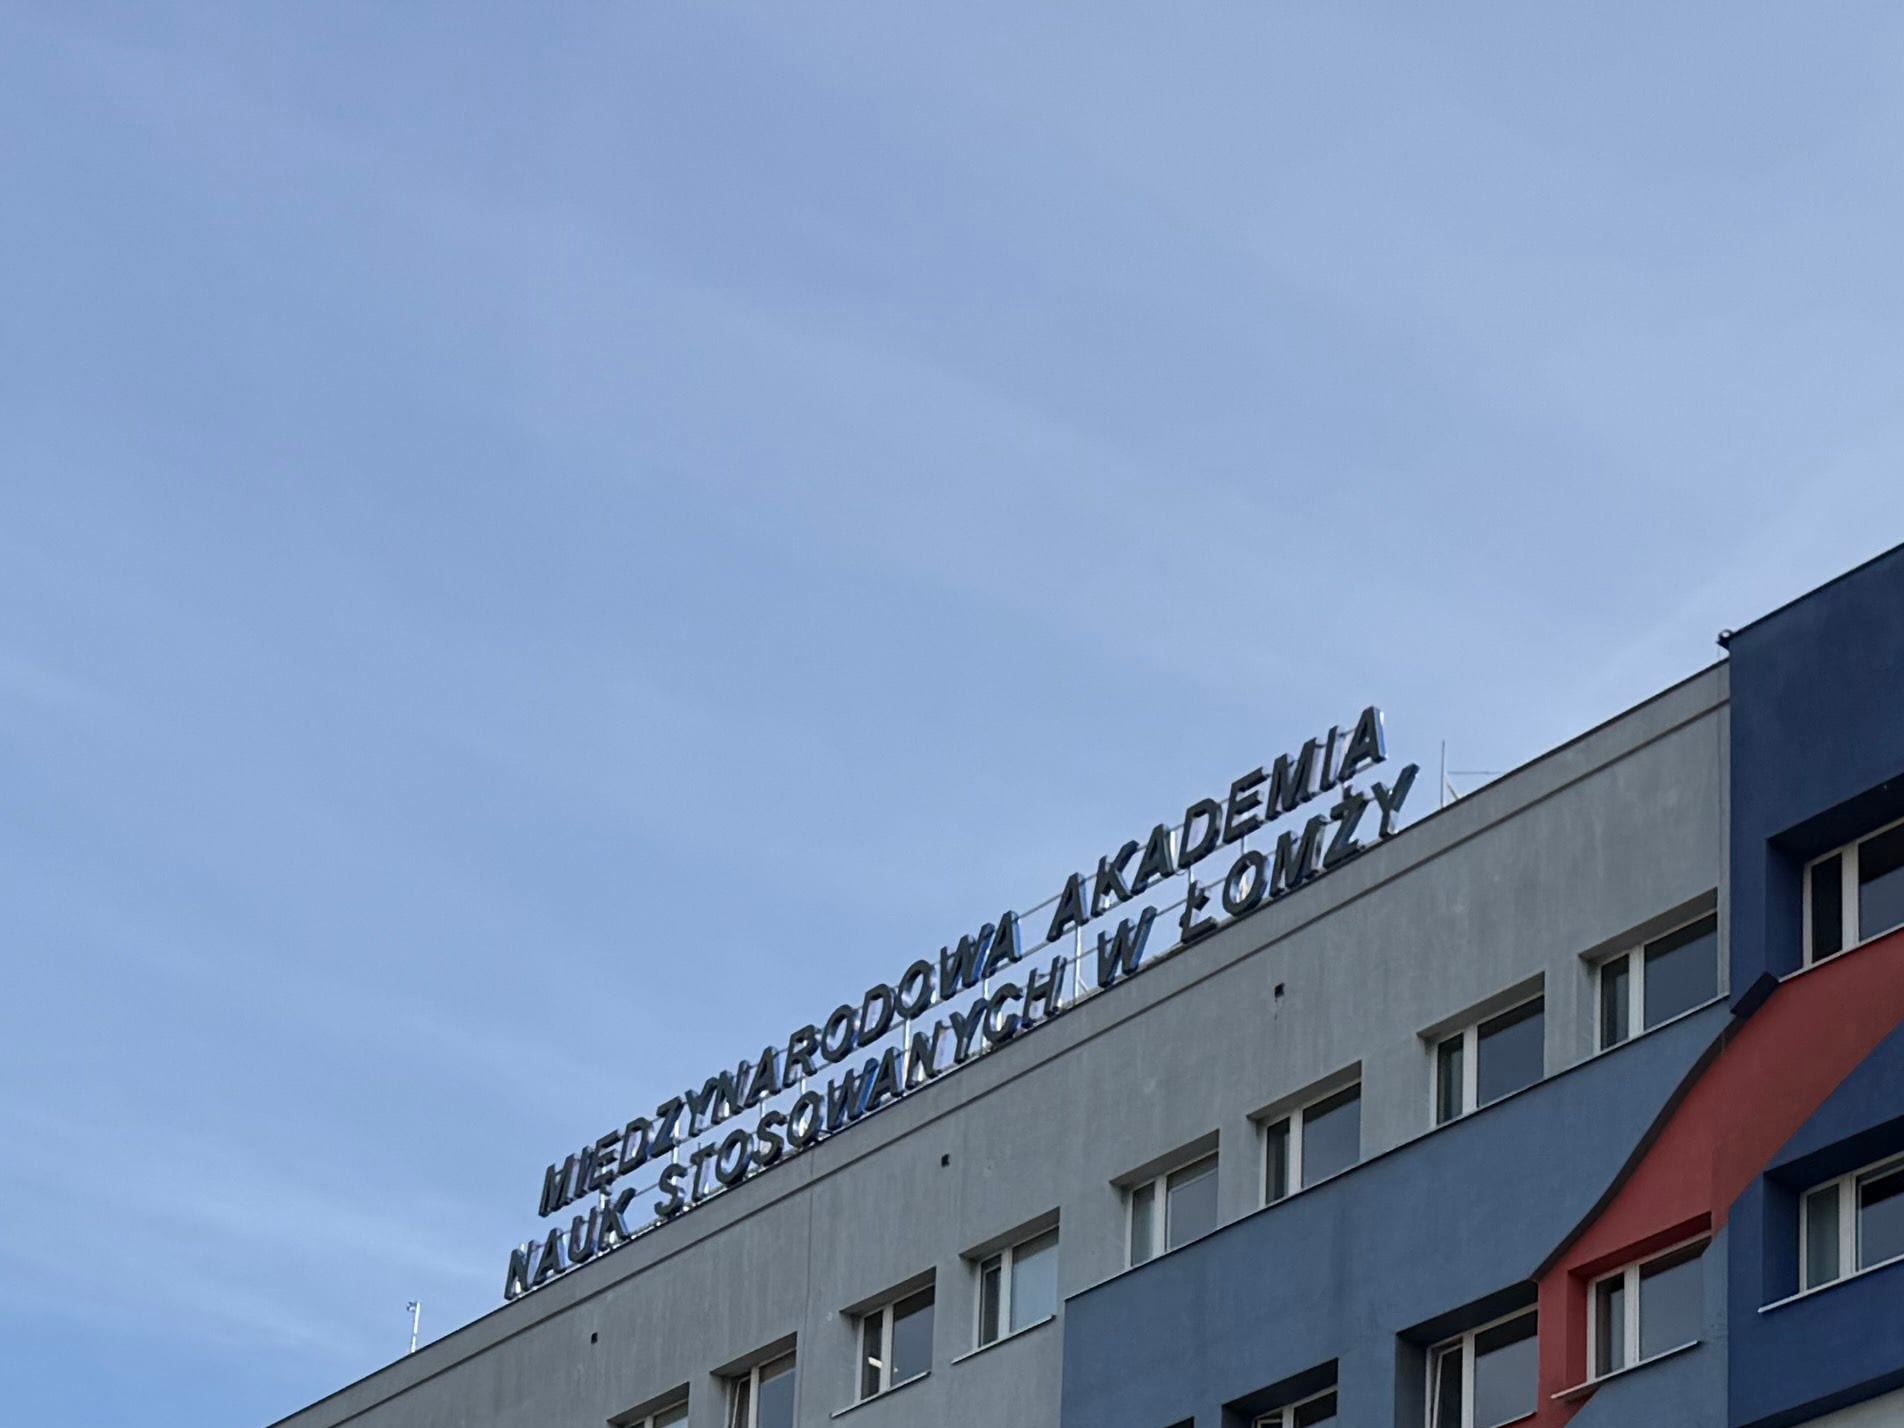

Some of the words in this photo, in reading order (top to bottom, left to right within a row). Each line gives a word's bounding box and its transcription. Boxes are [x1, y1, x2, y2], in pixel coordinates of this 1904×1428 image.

[504, 1187, 636, 1300] NAUK
[655, 955, 1067, 1218] STOSOWANYCH
[1097, 906, 1157, 988] W
[1180, 763, 1420, 944] ŁOMŻY
[538, 910, 1022, 1217] MIĘDZYNARODOWA
[1047, 705, 1388, 942] AKADEMIA
